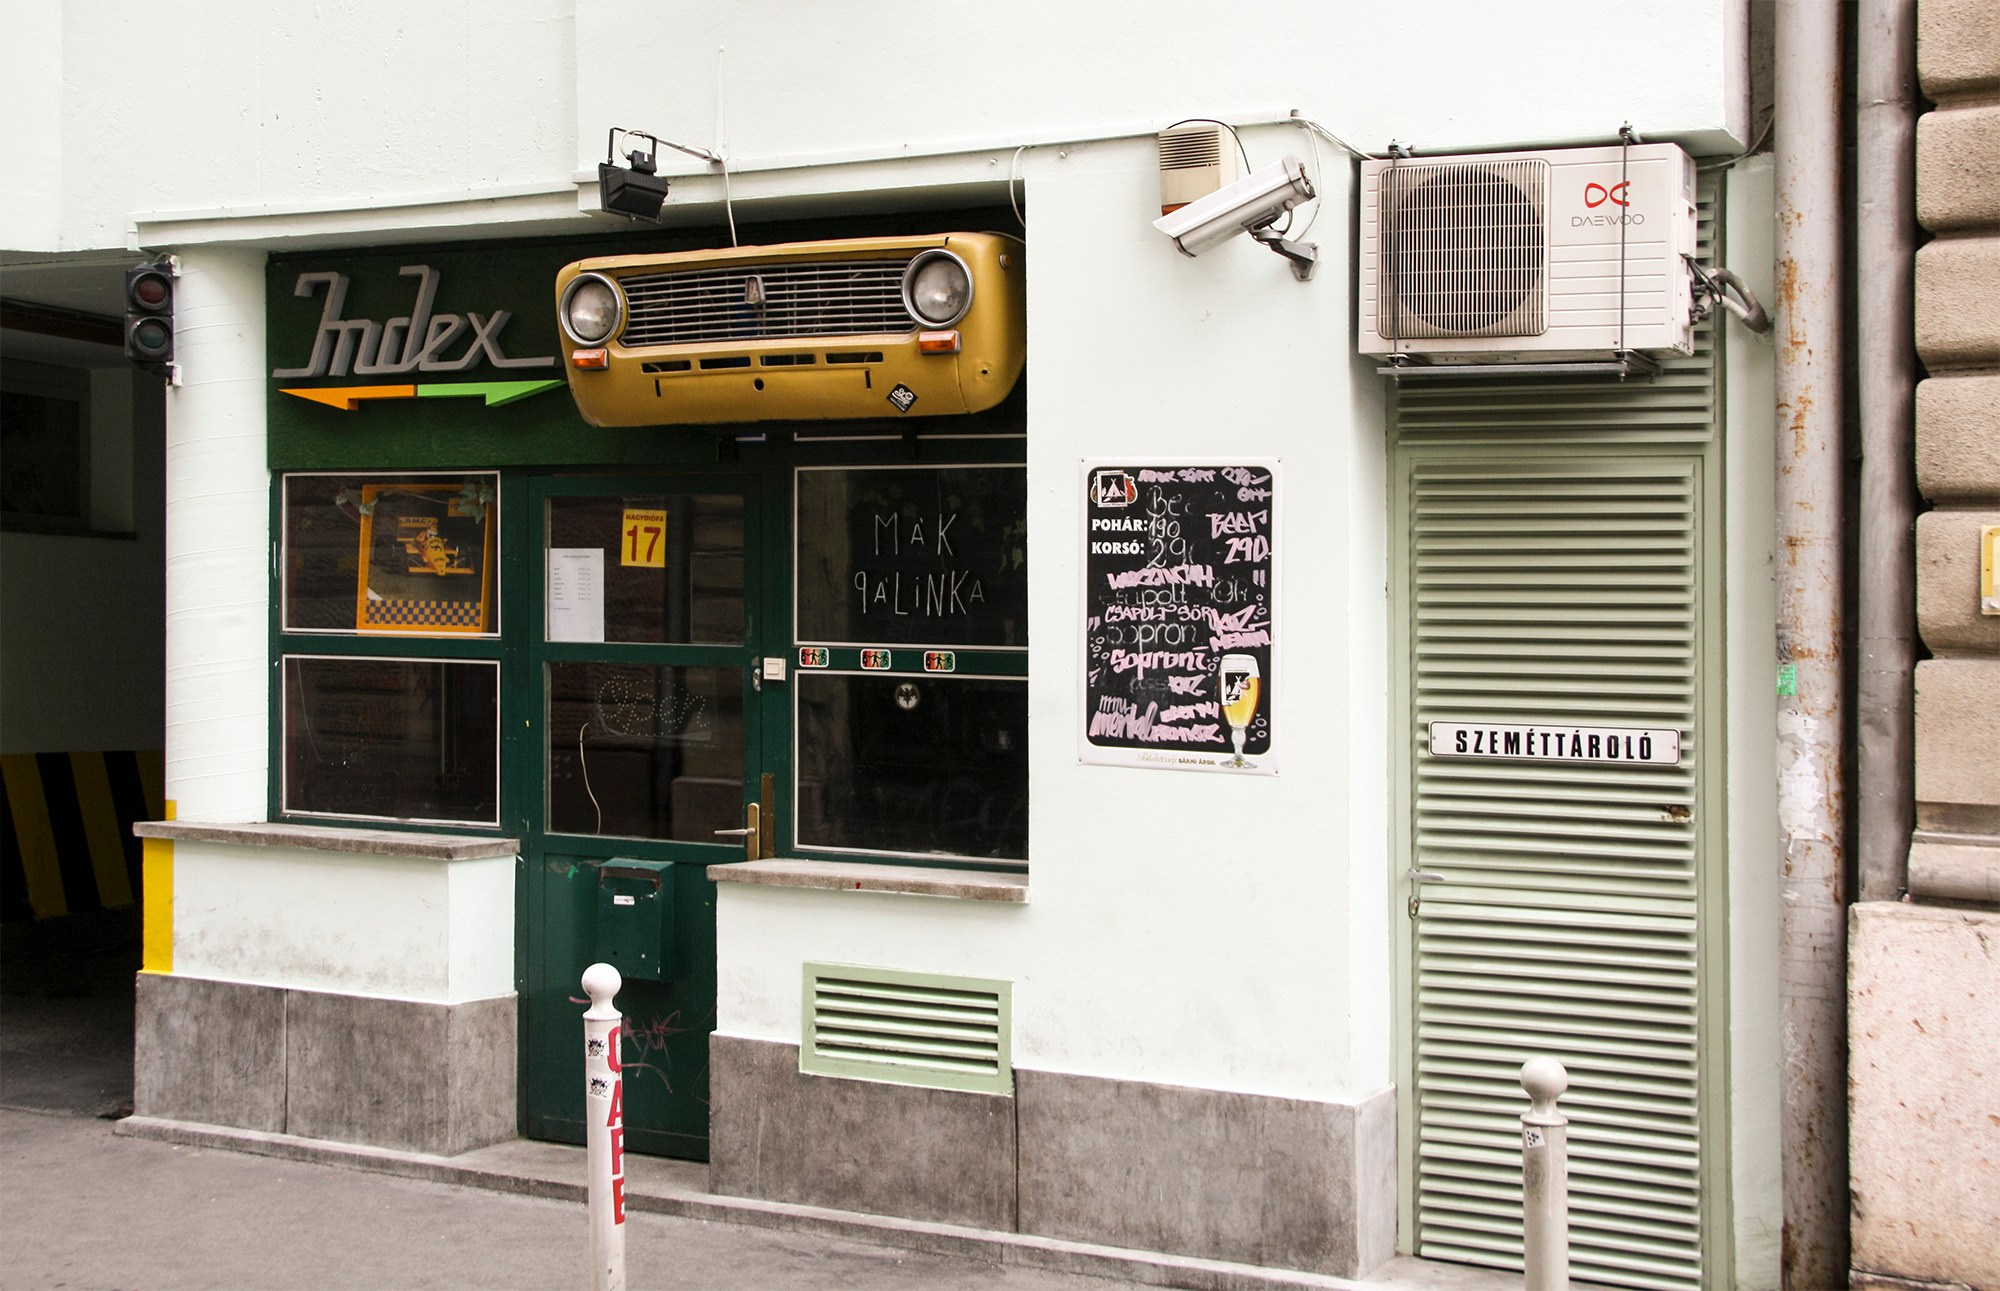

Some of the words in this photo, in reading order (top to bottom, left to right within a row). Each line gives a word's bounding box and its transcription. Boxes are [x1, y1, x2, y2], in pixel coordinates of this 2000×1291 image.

[1571, 214, 1645, 227] DAEWOO
[273, 264, 557, 378] Index
[626, 513, 665, 522] NAGYDIÓFA
[1092, 516, 1148, 531] POHÁR:
[626, 525, 662, 562] 17
[1092, 540, 1145, 555] KORSÓ:
[1455, 728, 1652, 760] SZEMÉTTÁROLÓ
